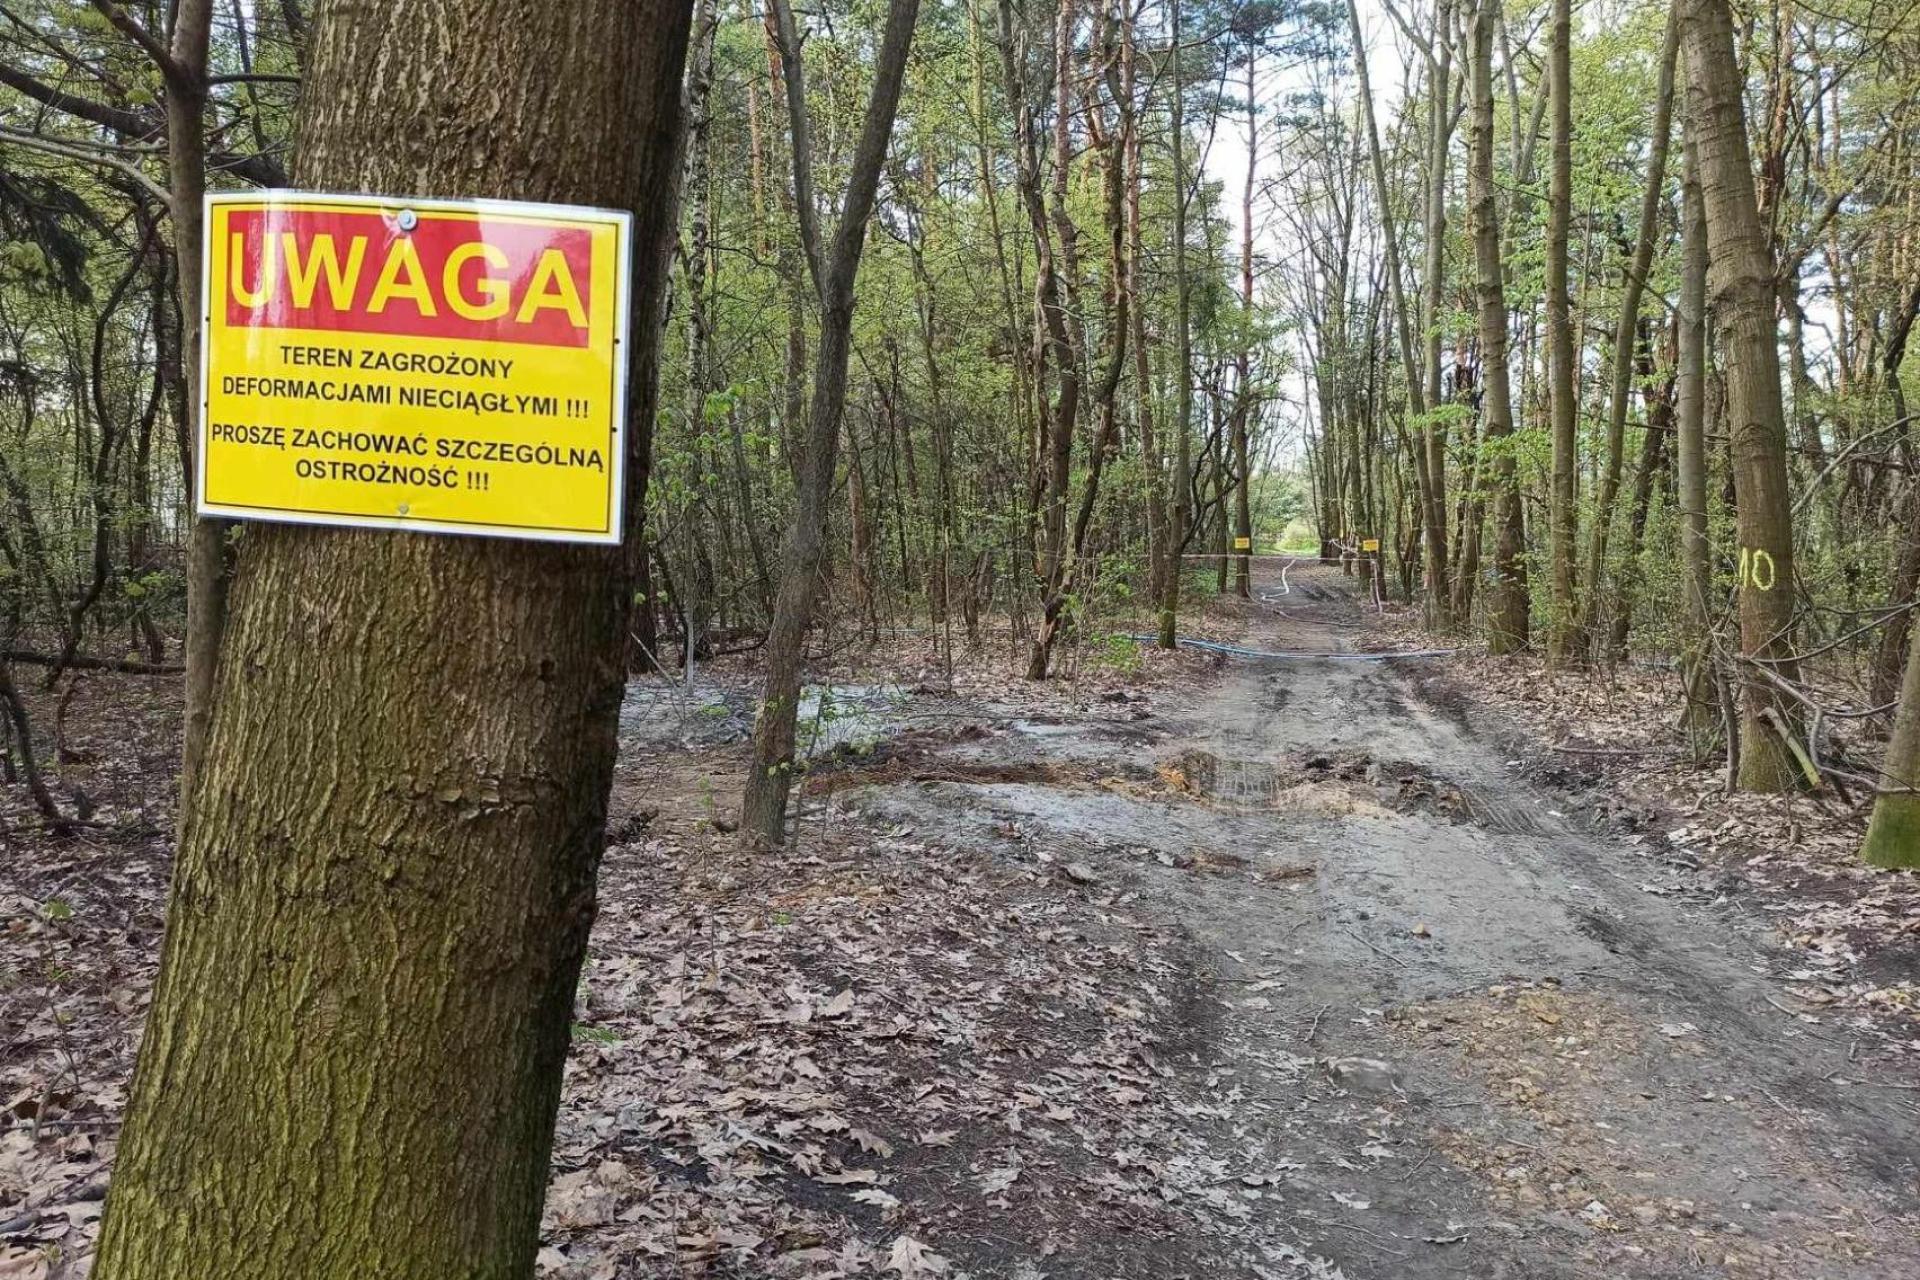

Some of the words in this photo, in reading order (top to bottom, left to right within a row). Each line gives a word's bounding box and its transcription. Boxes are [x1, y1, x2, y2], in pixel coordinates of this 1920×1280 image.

[231, 232, 589, 328] UWAGA
[280, 345, 352, 368] TEREN
[359, 350, 513, 379] ZAGROŻONY
[223, 376, 391, 405] DEFORMACJAMI
[399, 387, 558, 417] NIECIĄGŁYMI
[566, 398, 589, 418] !!!
[212, 423, 286, 450] PROSZĘ
[292, 428, 428, 456] ZACHOWAĆ
[436, 437, 604, 472] SZCZEGÓLNĄ
[295, 458, 459, 489] OSTROŻNOŚĆ
[466, 470, 490, 490] !!!
